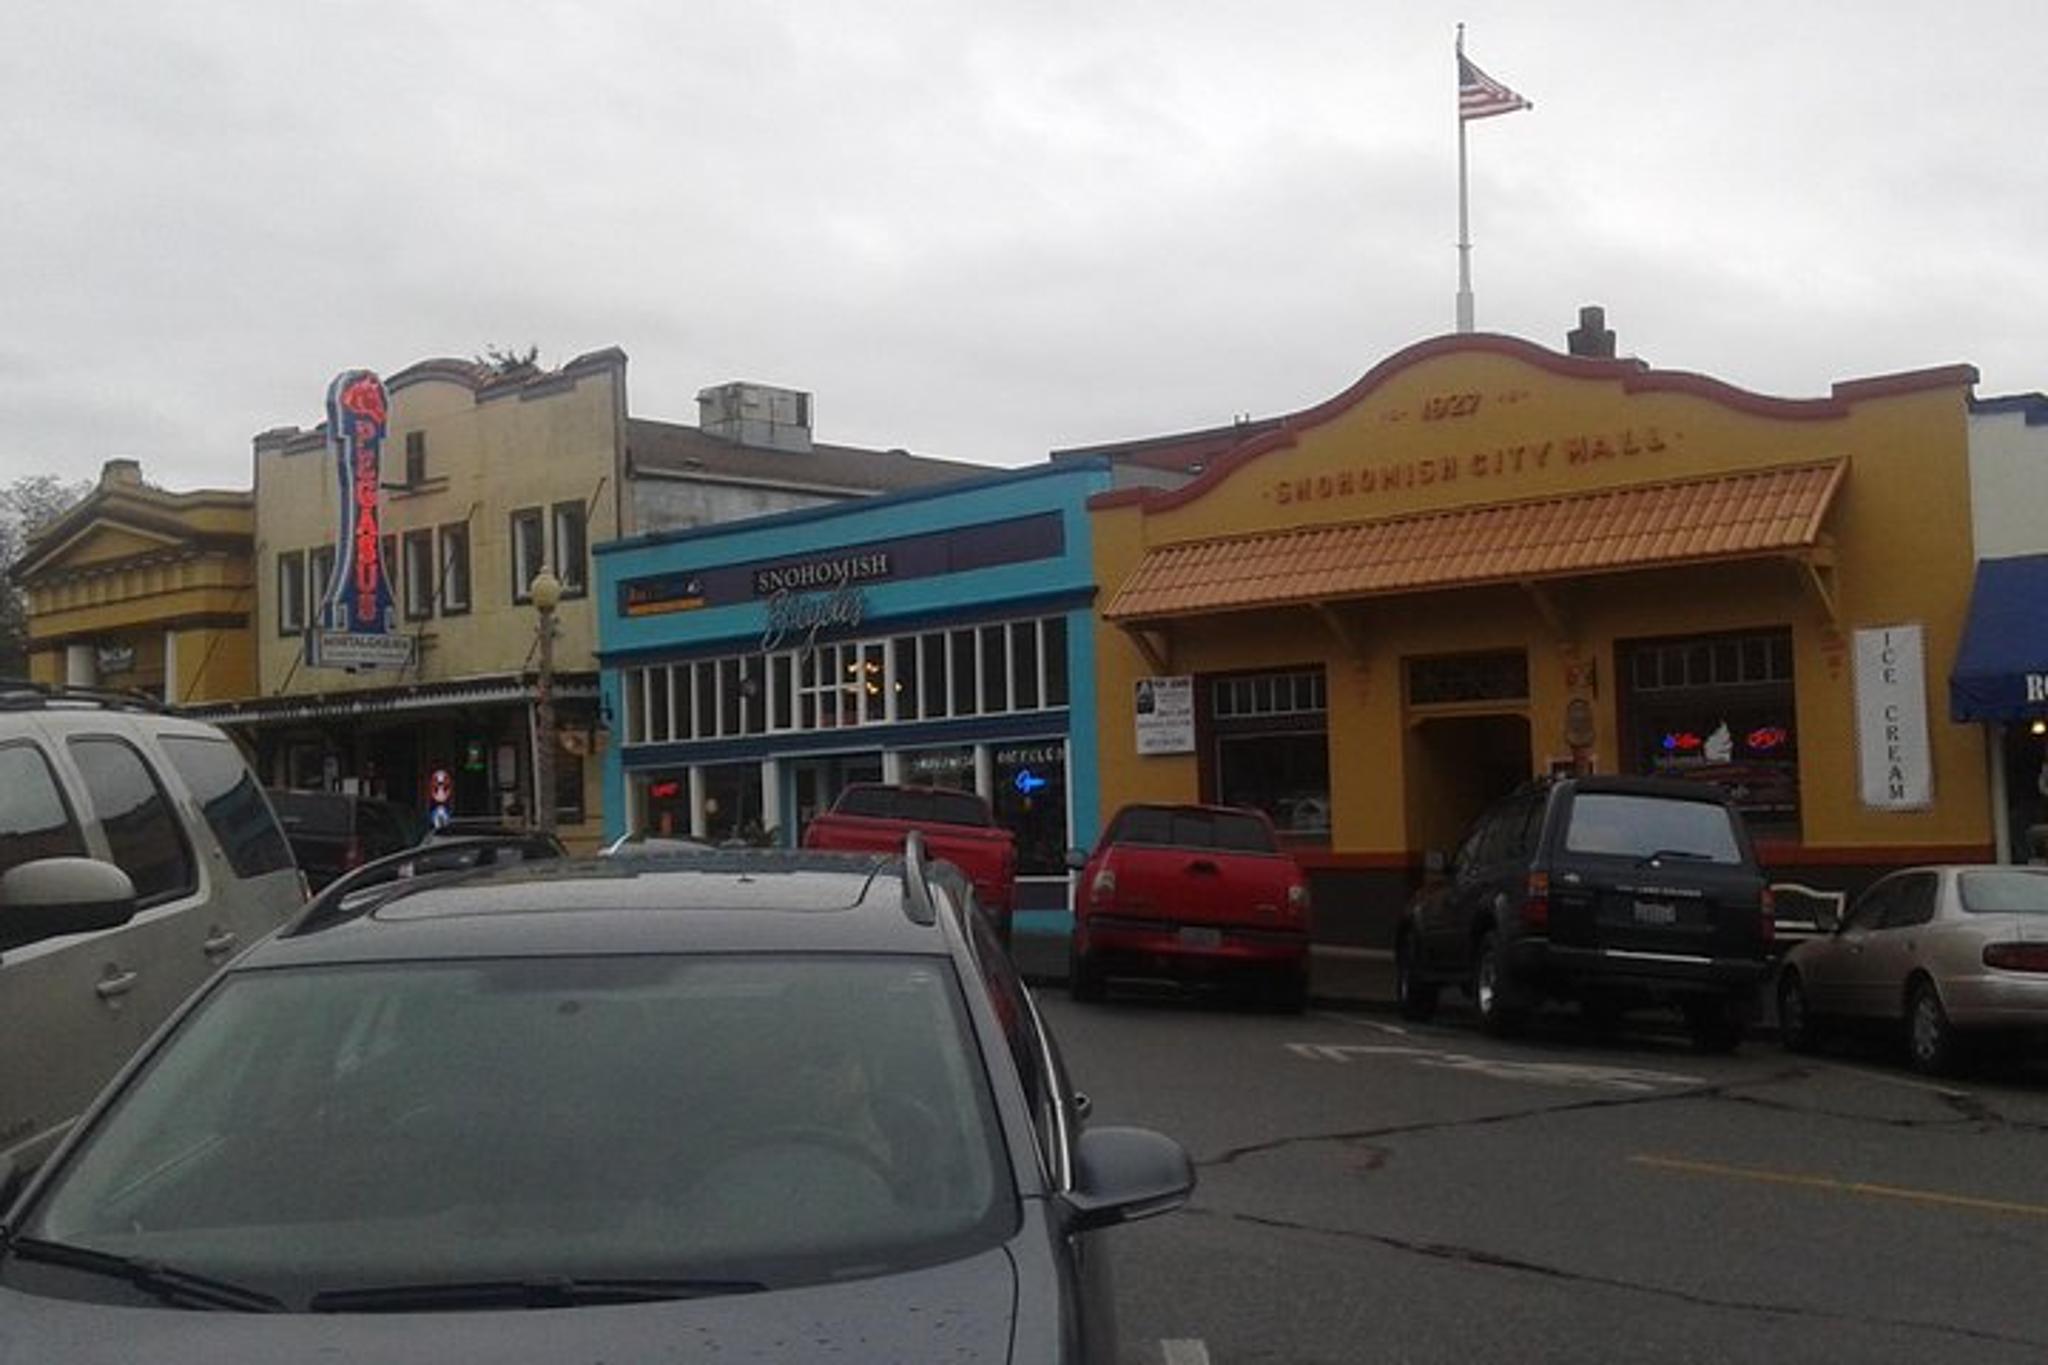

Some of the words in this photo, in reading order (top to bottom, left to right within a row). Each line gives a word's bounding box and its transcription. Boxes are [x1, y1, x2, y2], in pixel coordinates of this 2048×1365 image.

[1422, 391, 1482, 421] 1927
[1275, 455, 1458, 505] SNOHOMISH
[1472, 440, 1553, 478] CITY
[1567, 429, 1667, 467] HALL
[354, 419, 378, 622] PEGASUS
[759, 553, 888, 592] SNOHOMISH
[1881, 631, 1898, 684] ICE
[1884, 704, 1905, 799] CREAM
